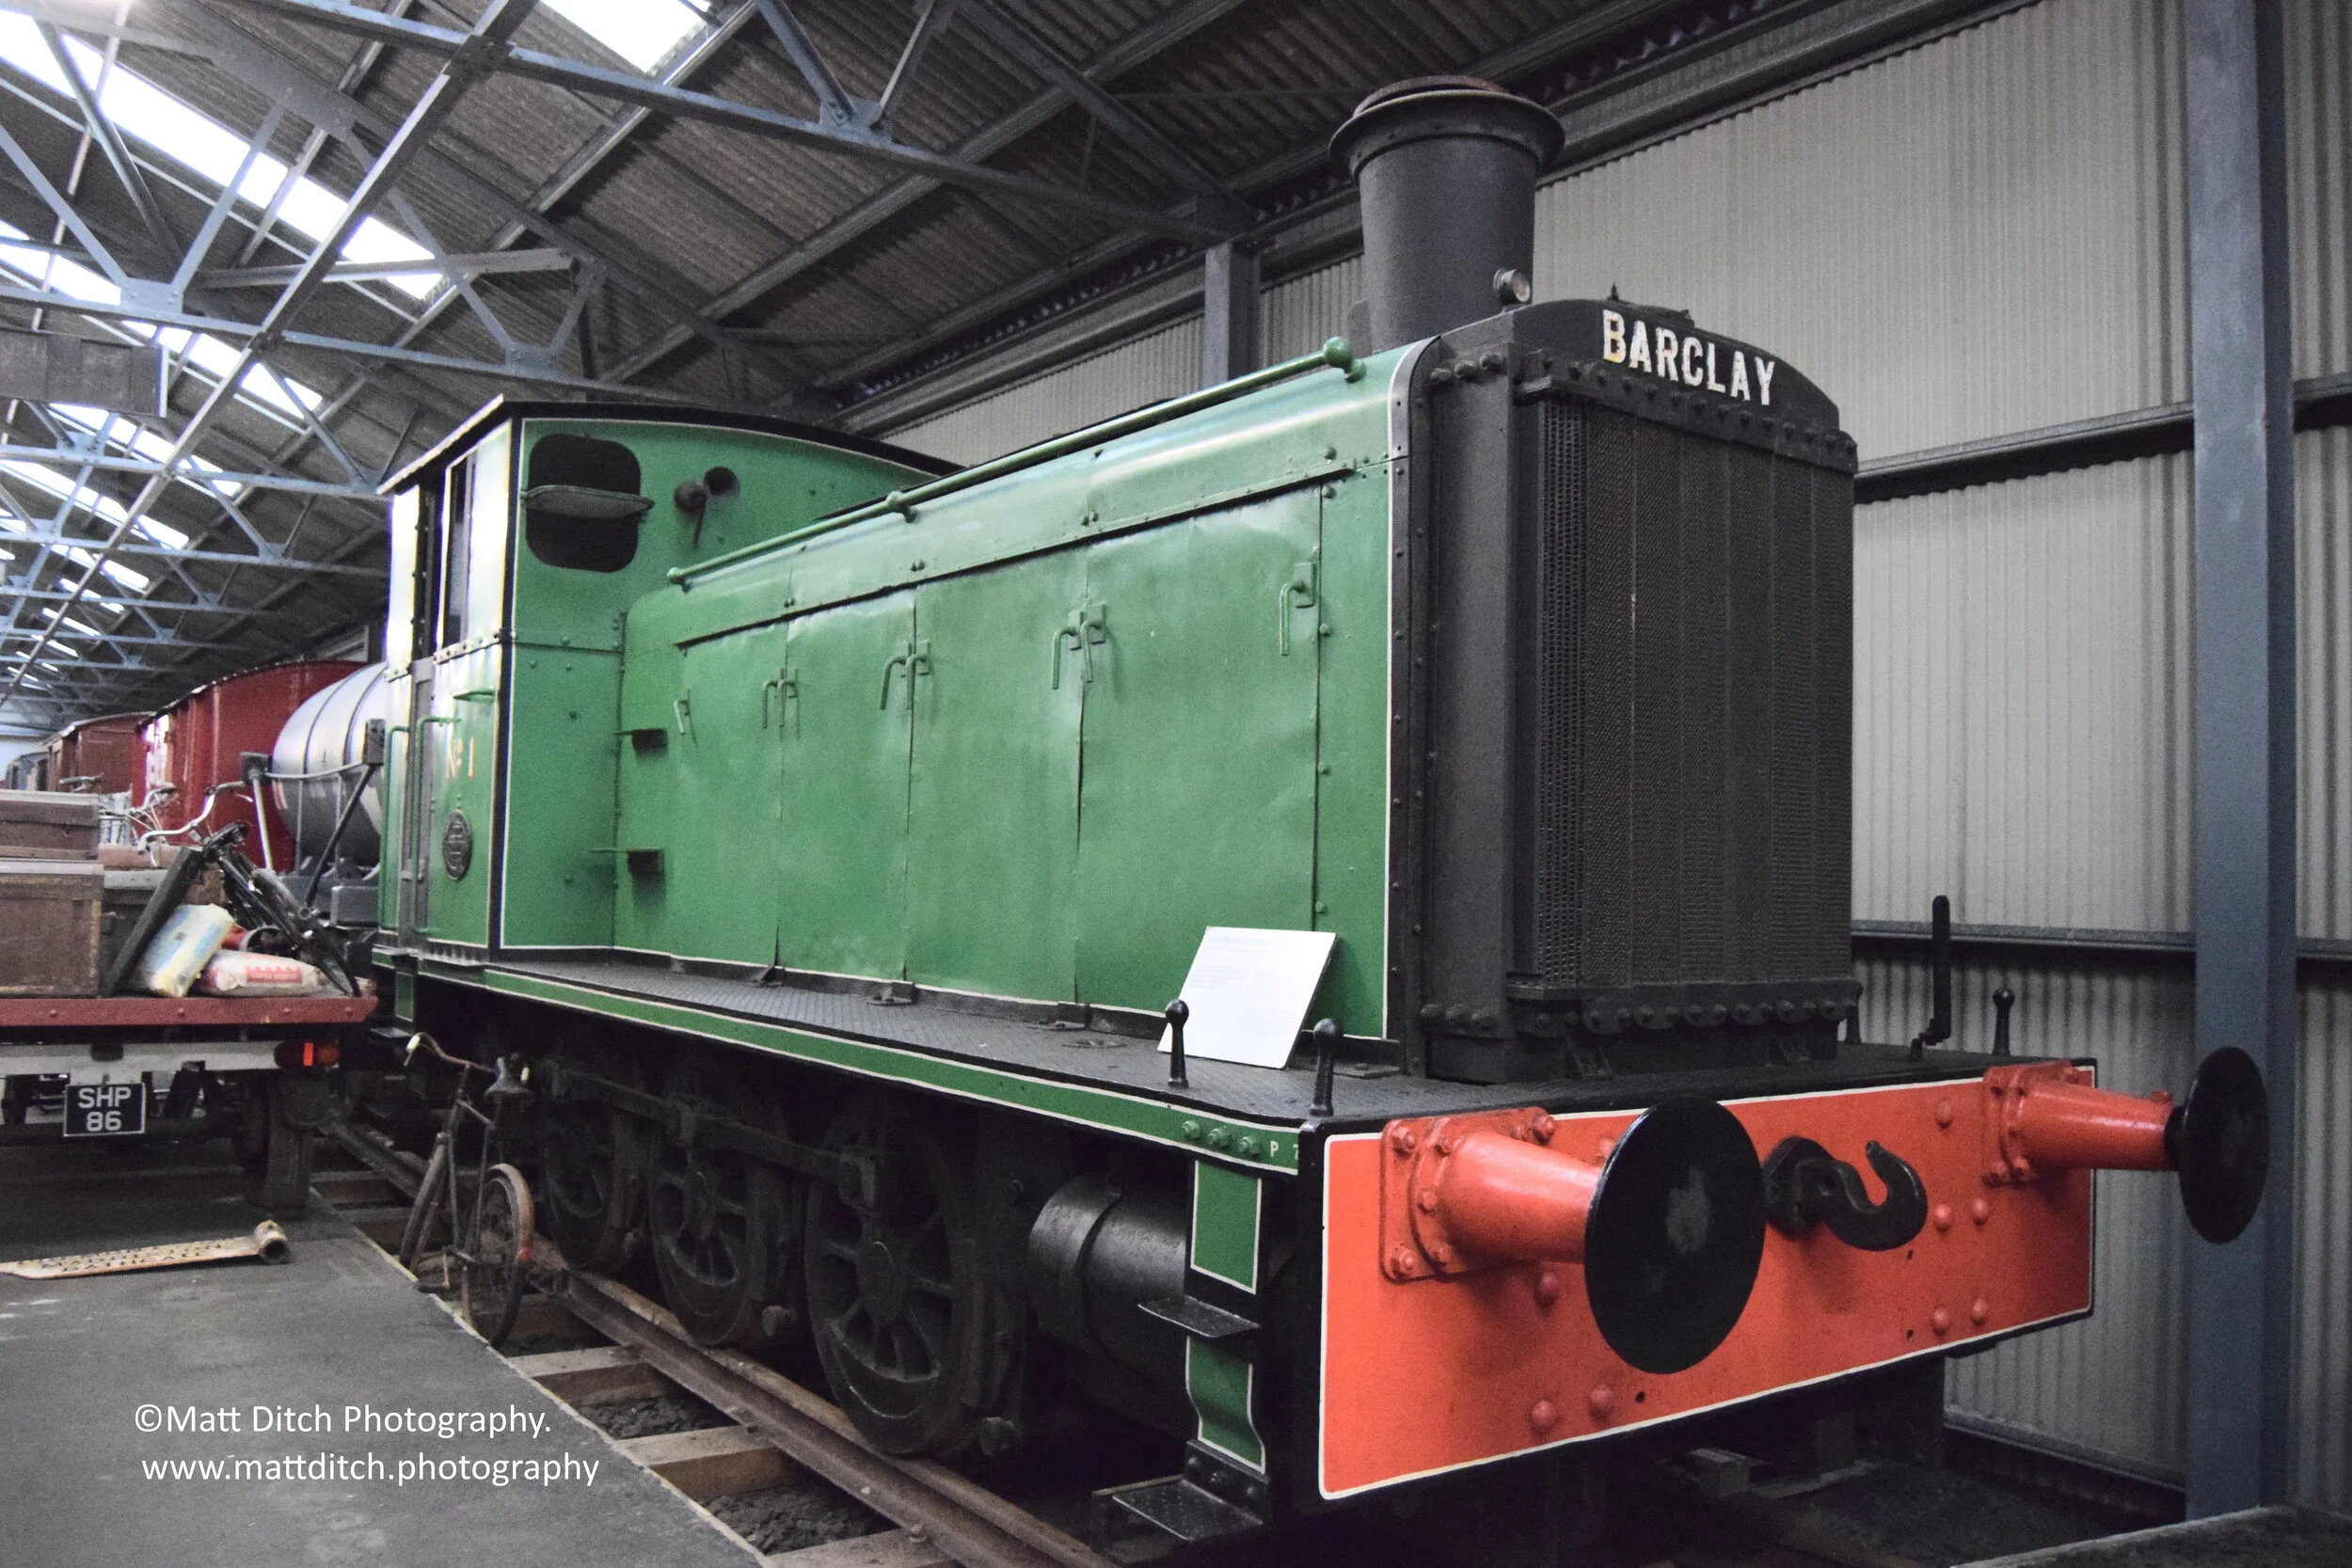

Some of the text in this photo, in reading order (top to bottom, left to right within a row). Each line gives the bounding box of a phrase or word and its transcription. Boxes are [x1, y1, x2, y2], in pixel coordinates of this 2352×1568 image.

[1602, 309, 1775, 406] BARCLAY
[78, 1086, 132, 1108] SHP
[87, 1111, 122, 1132] 86
